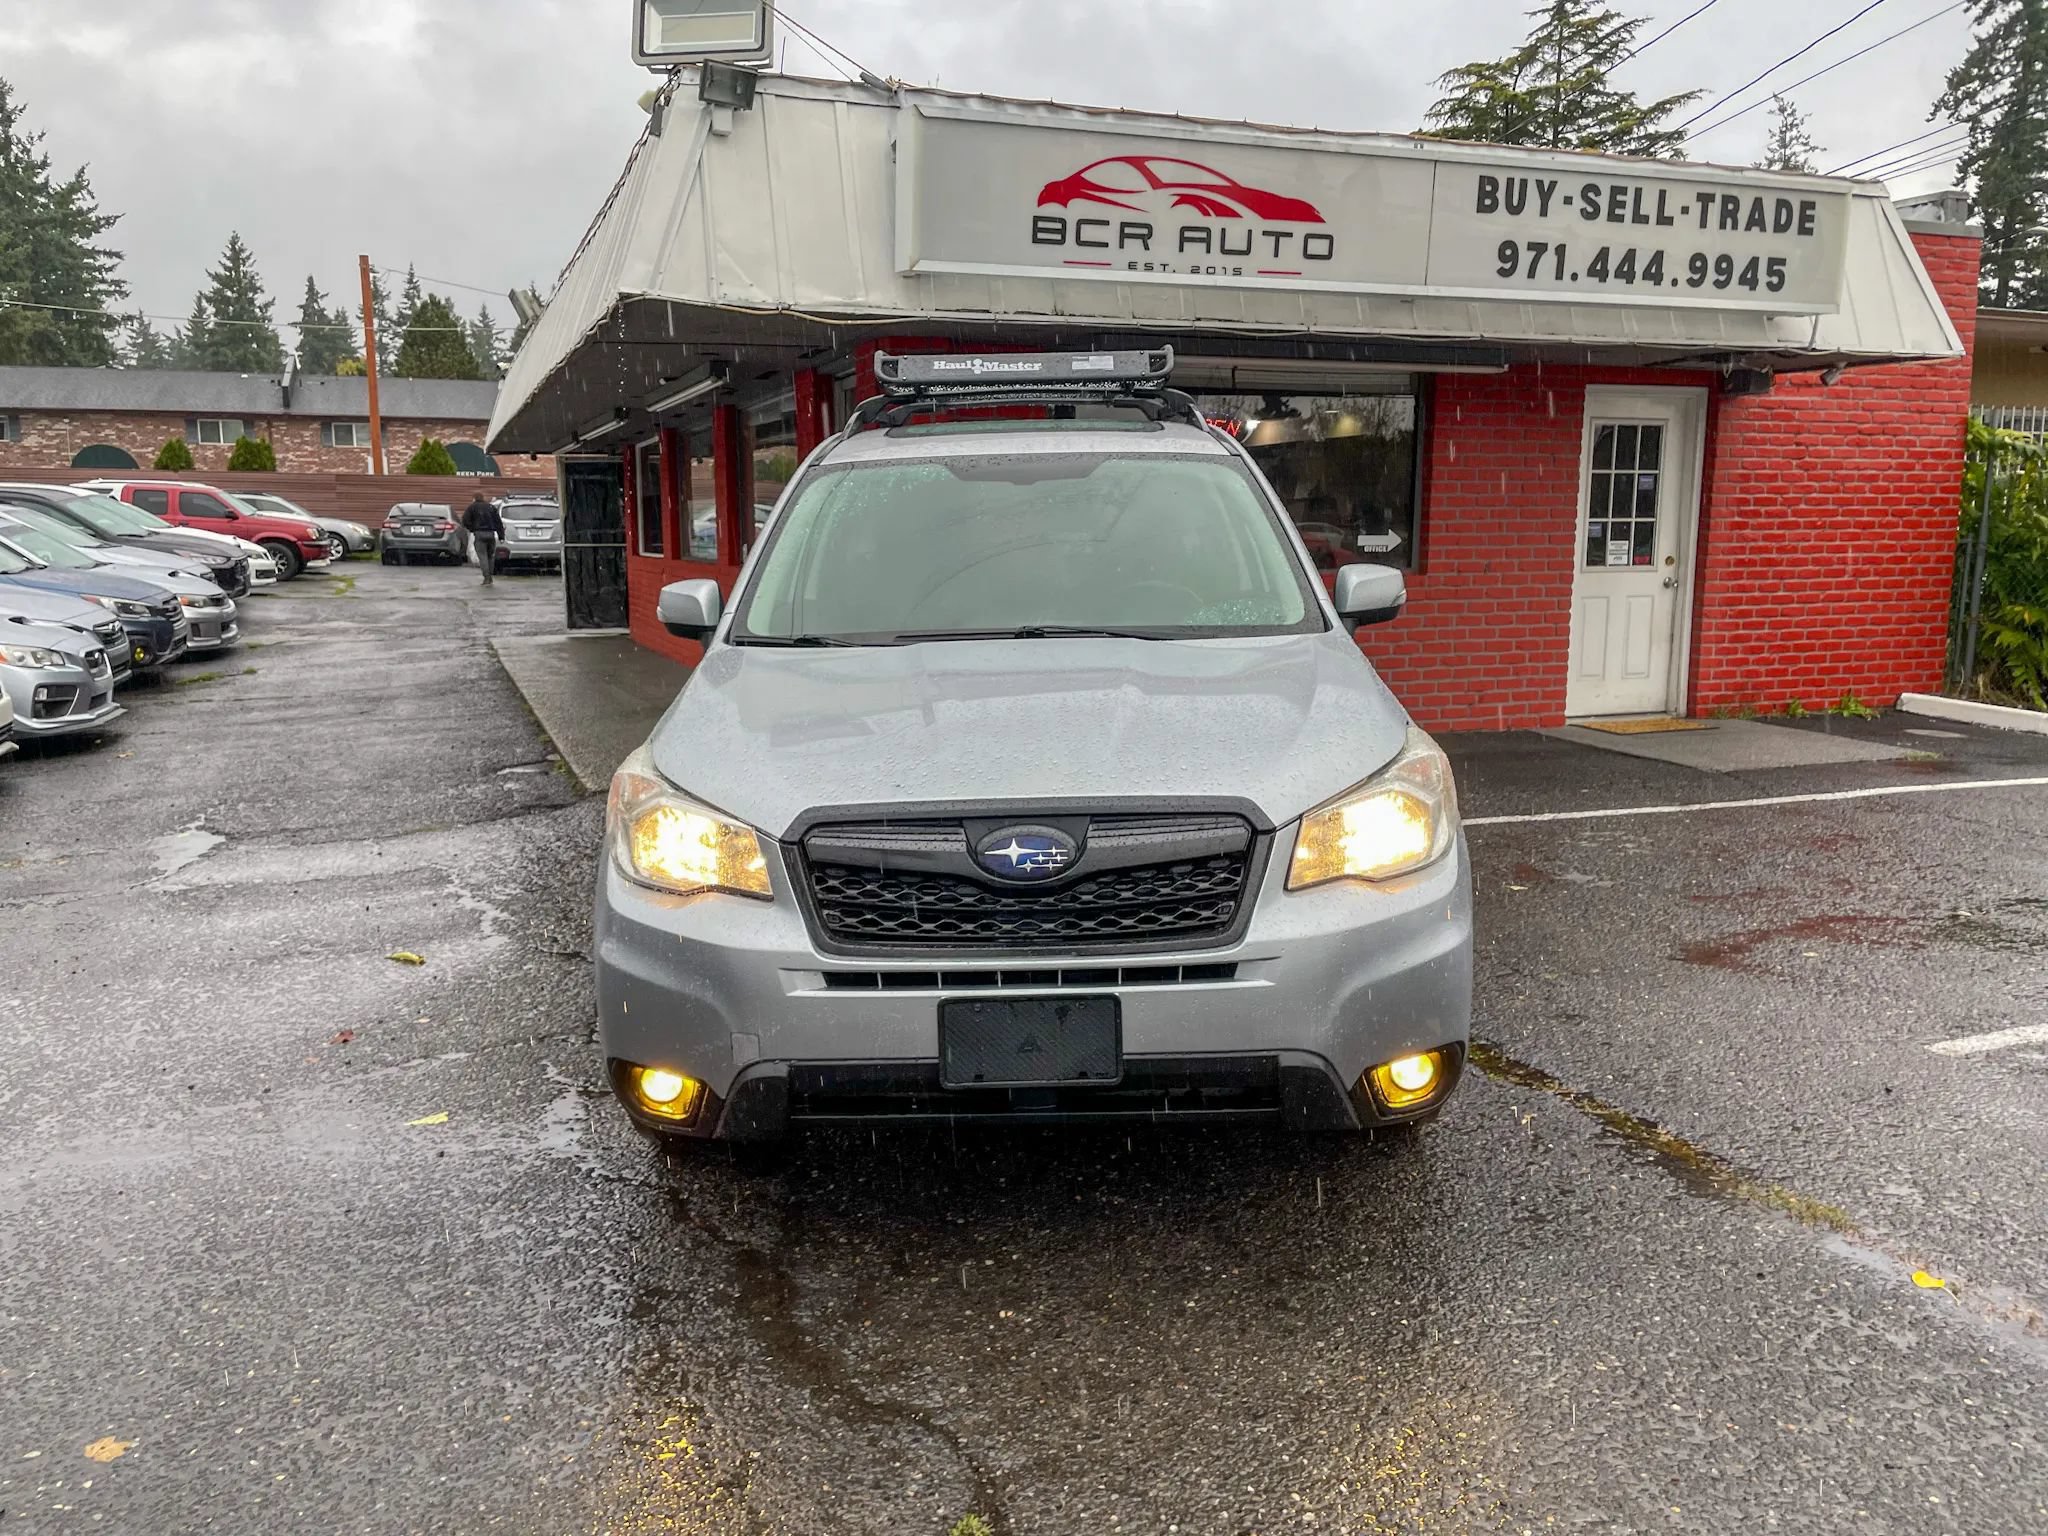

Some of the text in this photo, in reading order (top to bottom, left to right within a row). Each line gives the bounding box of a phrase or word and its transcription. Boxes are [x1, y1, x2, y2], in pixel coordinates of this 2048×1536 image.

[1032, 215, 1334, 260] BCR AUTO
[1128, 261, 1243, 276] EST. 2015
[1496, 239, 1788, 293] 971.444.9945
[933, 360, 1042, 372] Haul Master
